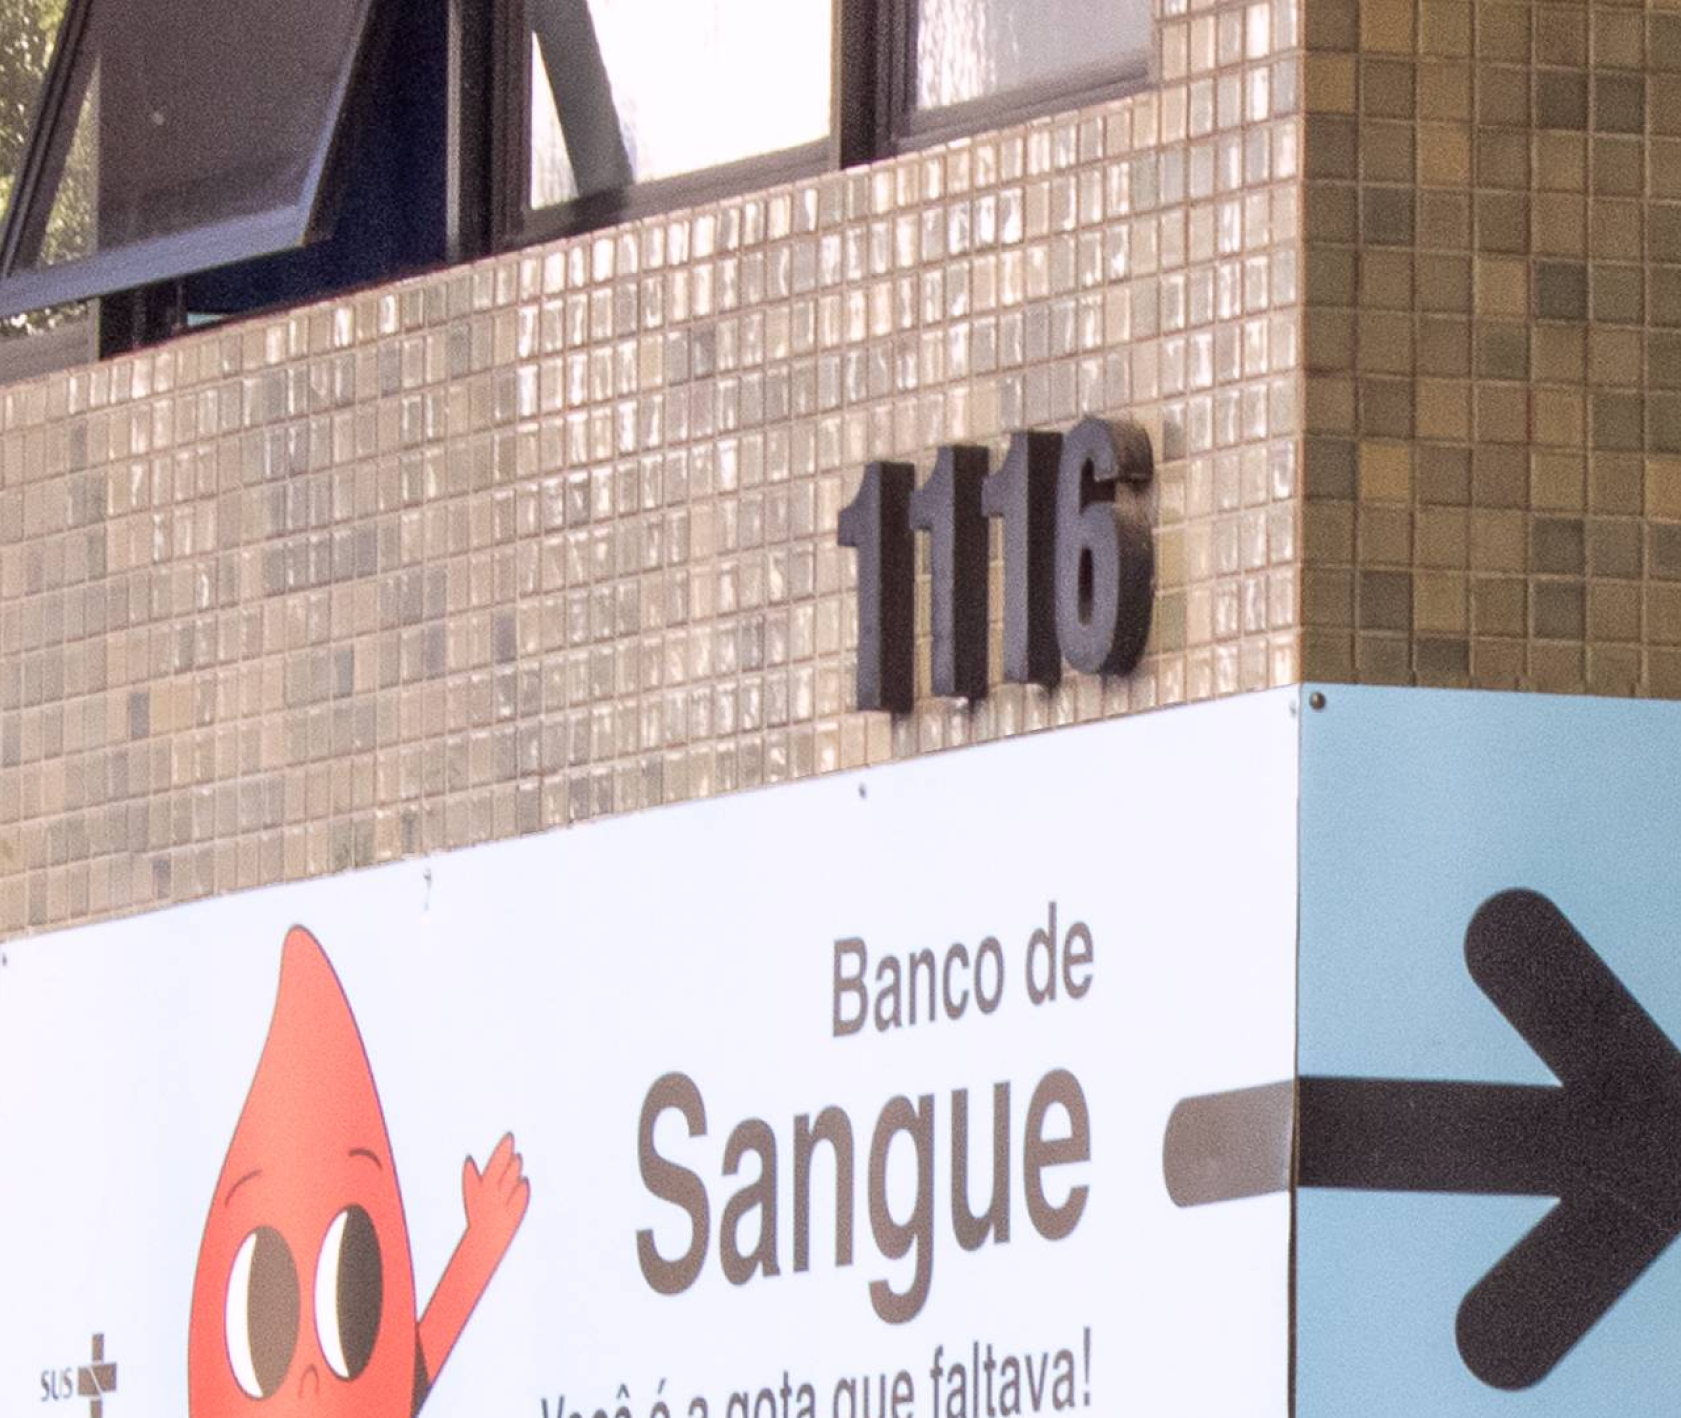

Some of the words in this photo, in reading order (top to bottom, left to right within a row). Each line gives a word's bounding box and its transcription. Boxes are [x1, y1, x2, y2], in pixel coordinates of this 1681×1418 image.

[837, 415, 1153, 714] 1116
[832, 935, 1005, 1038] Banco
[1025, 900, 1094, 1007] de
[635, 1067, 1091, 1325] Sangue
[40, 1366, 74, 1402] SUS
